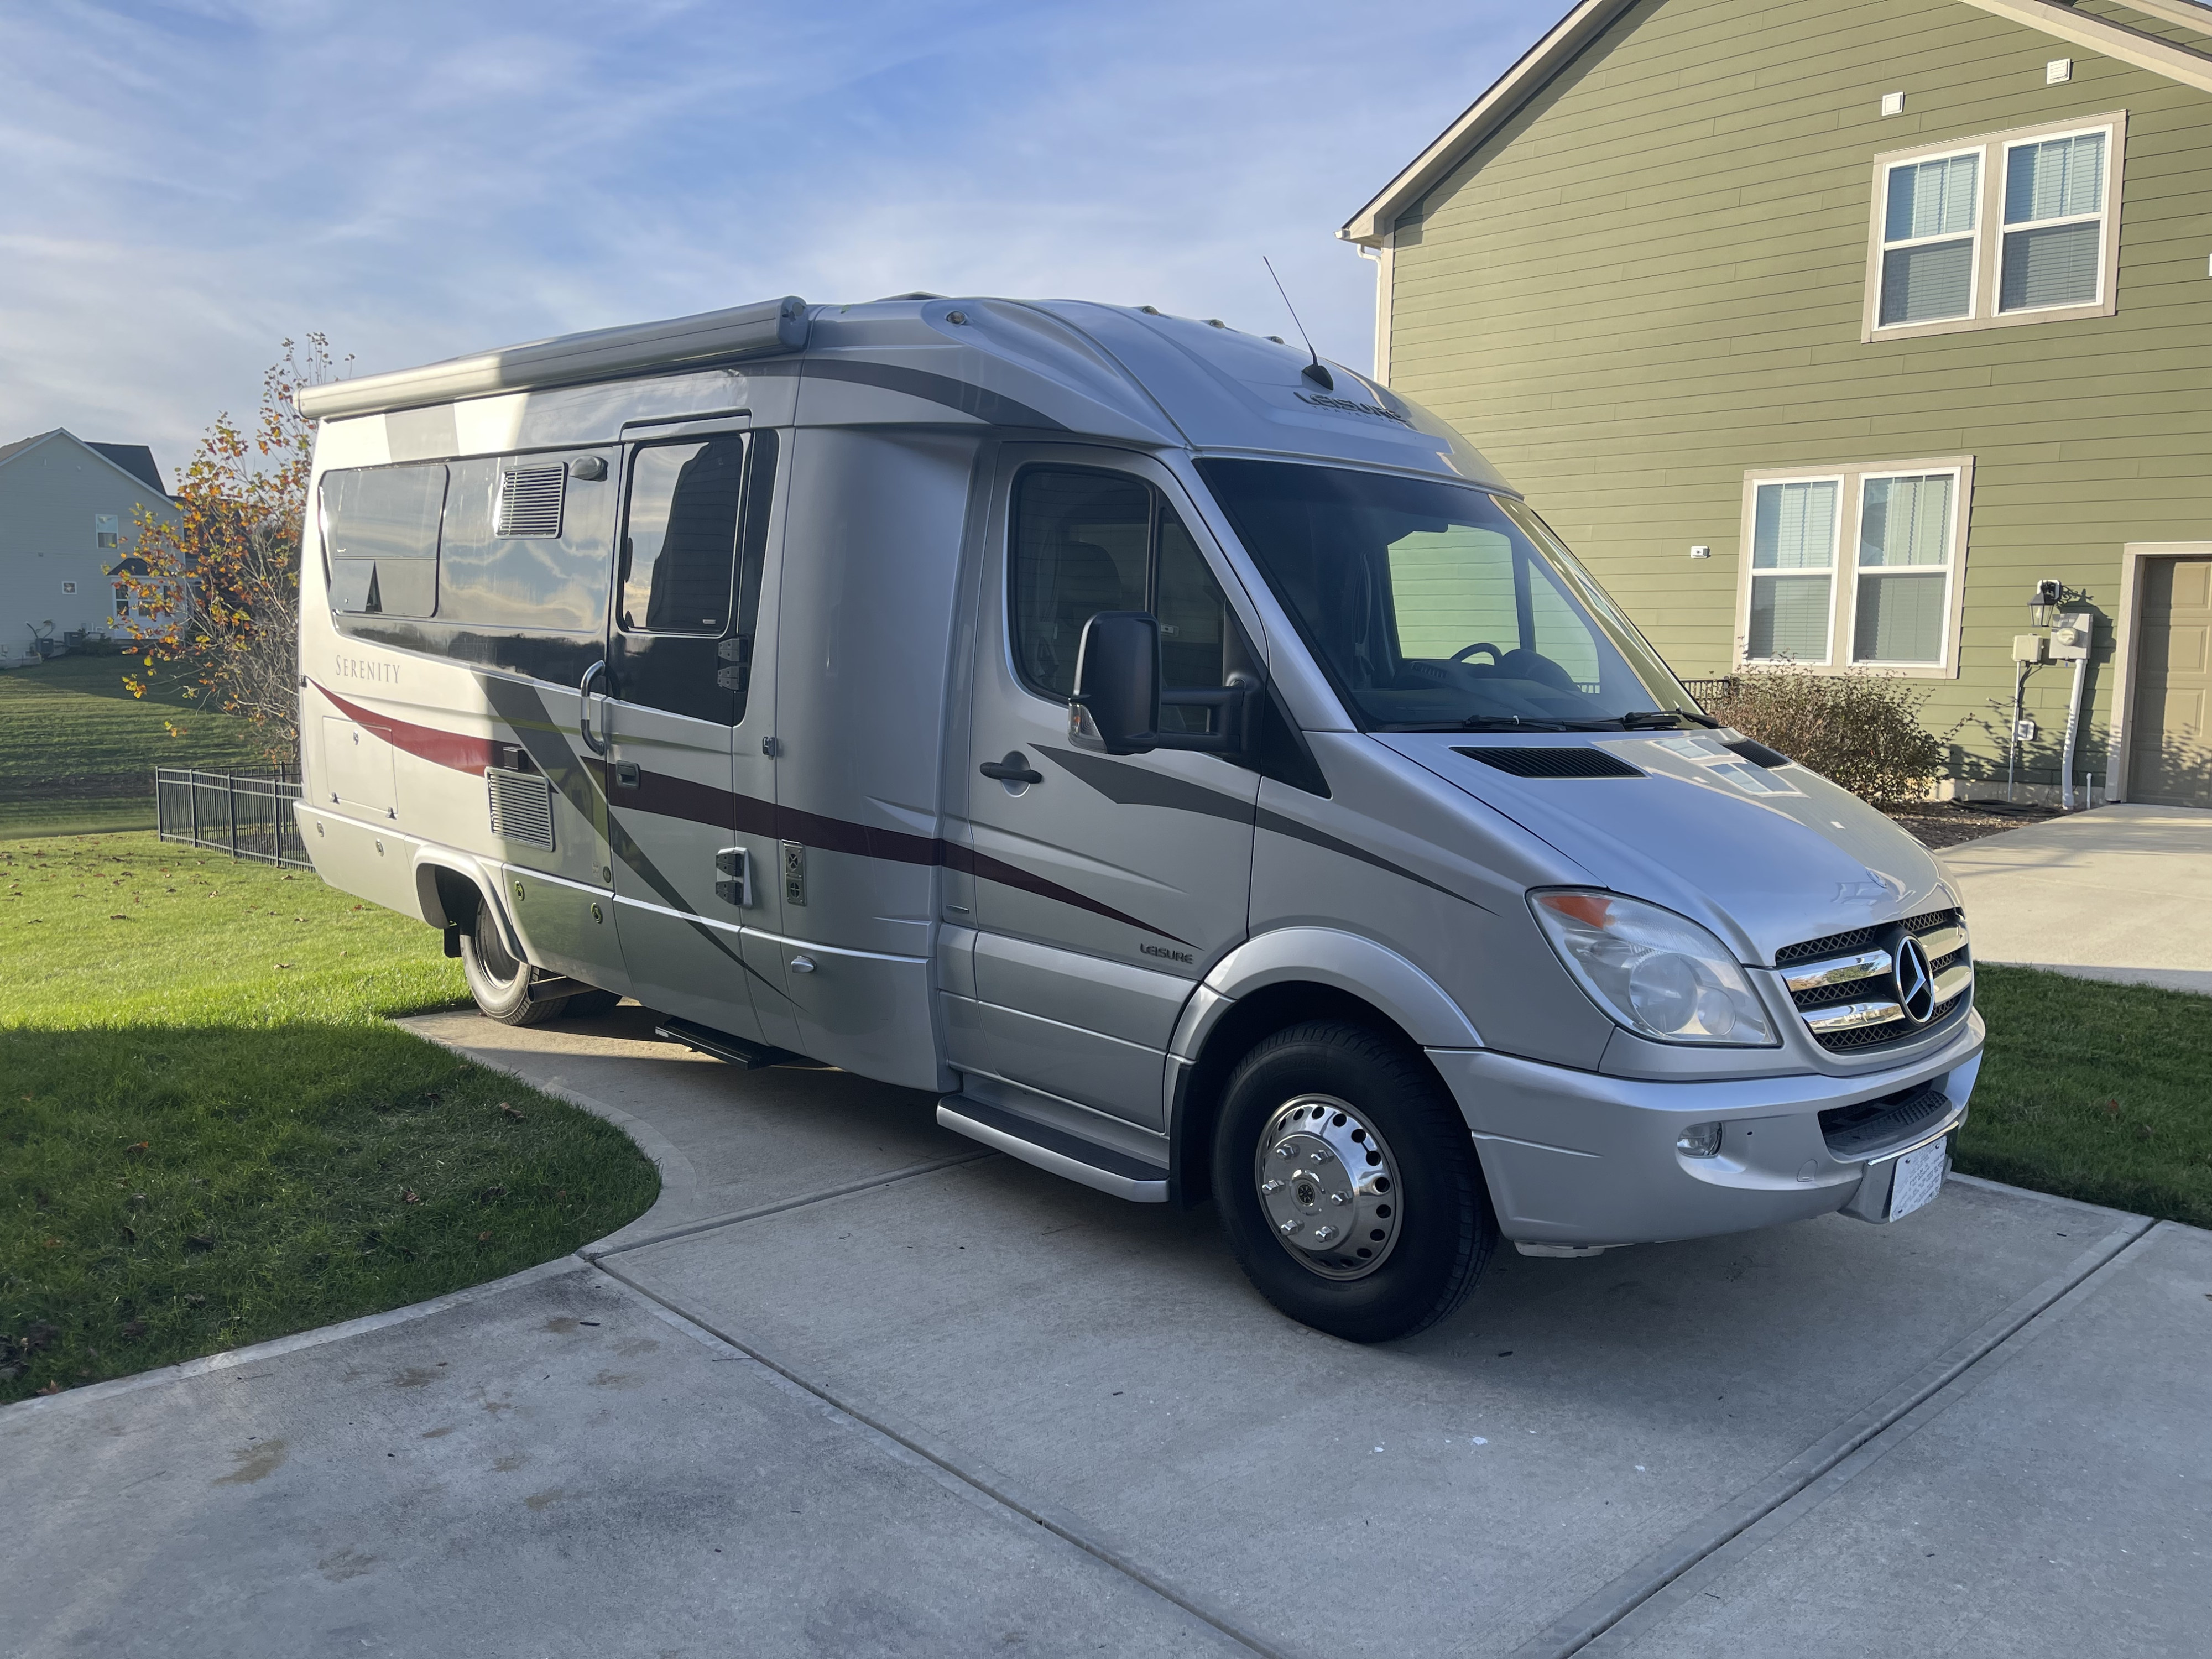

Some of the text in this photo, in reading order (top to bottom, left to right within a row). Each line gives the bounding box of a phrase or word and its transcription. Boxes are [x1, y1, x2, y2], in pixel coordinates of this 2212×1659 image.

[1293, 392, 1407, 422] LEISURE
[1311, 405, 1372, 419] TRAVEL
[336, 654, 400, 684] SERENITY
[1140, 943, 1193, 964] LEISURE
